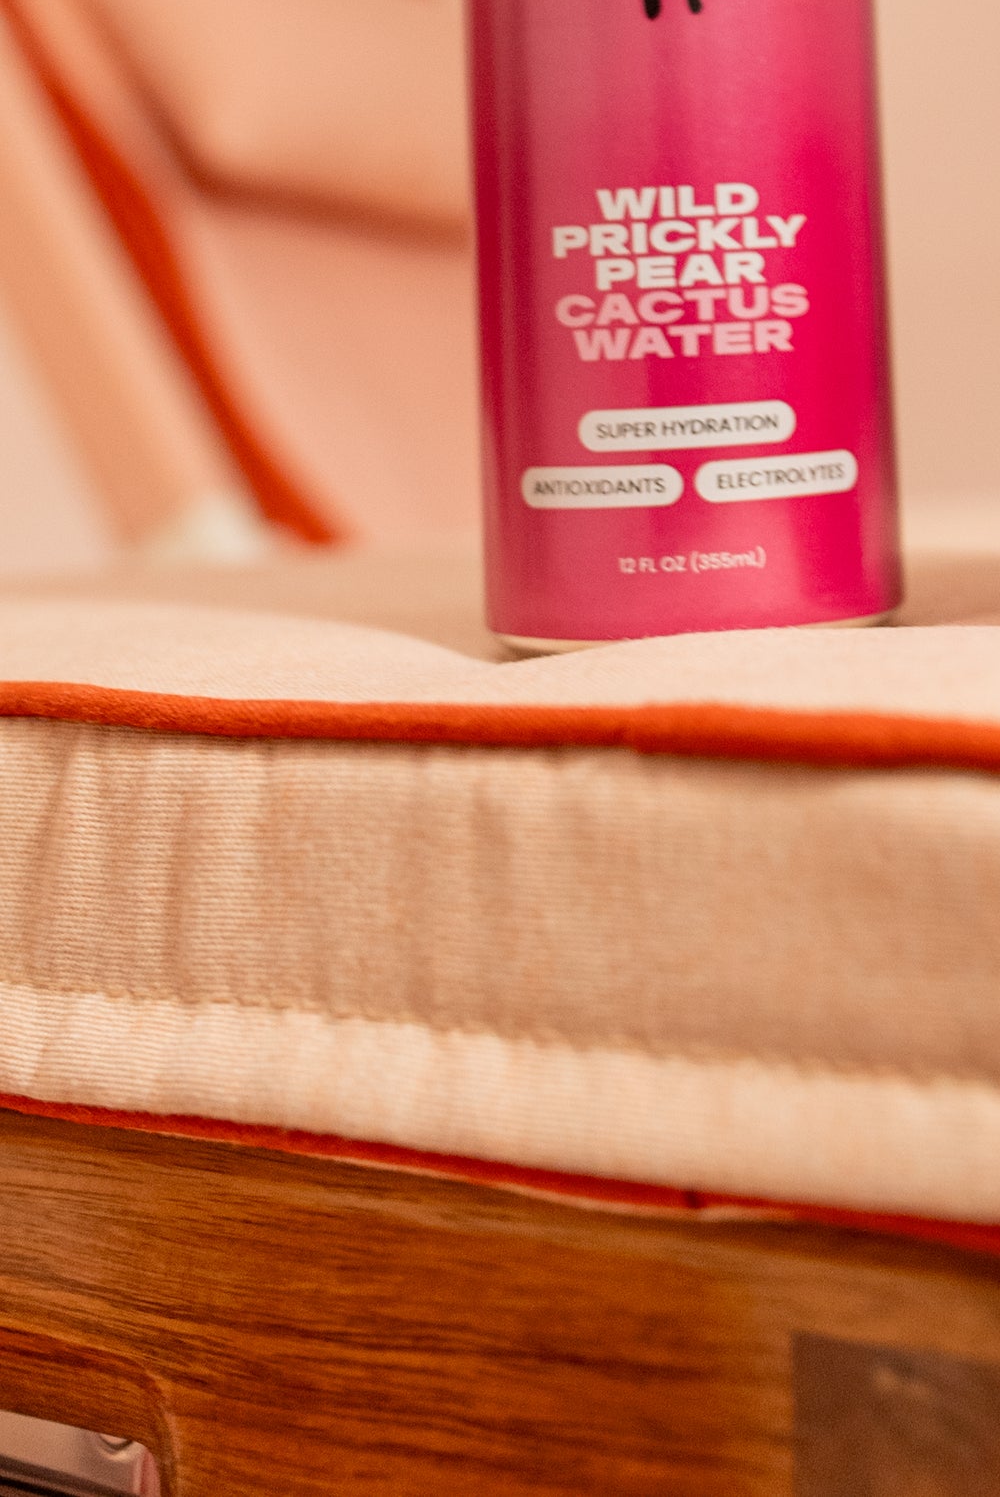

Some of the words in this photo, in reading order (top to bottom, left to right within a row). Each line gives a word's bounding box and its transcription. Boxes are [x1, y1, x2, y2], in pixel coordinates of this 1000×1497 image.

[596, 182, 759, 221] WILD
[553, 214, 807, 258] PRICKLY
[595, 250, 766, 291] PEAR
[556, 284, 811, 329] CACTUS
[573, 320, 794, 362] WATER
[596, 420, 656, 440] SUPER
[661, 413, 780, 436] HYDRATION
[534, 476, 666, 496] ANTIOXIDANTS
[716, 462, 846, 490] ELECTROLYTES
[618, 557, 637, 574] 12
[638, 557, 658, 573] FL
[660, 555, 687, 572] OZ
